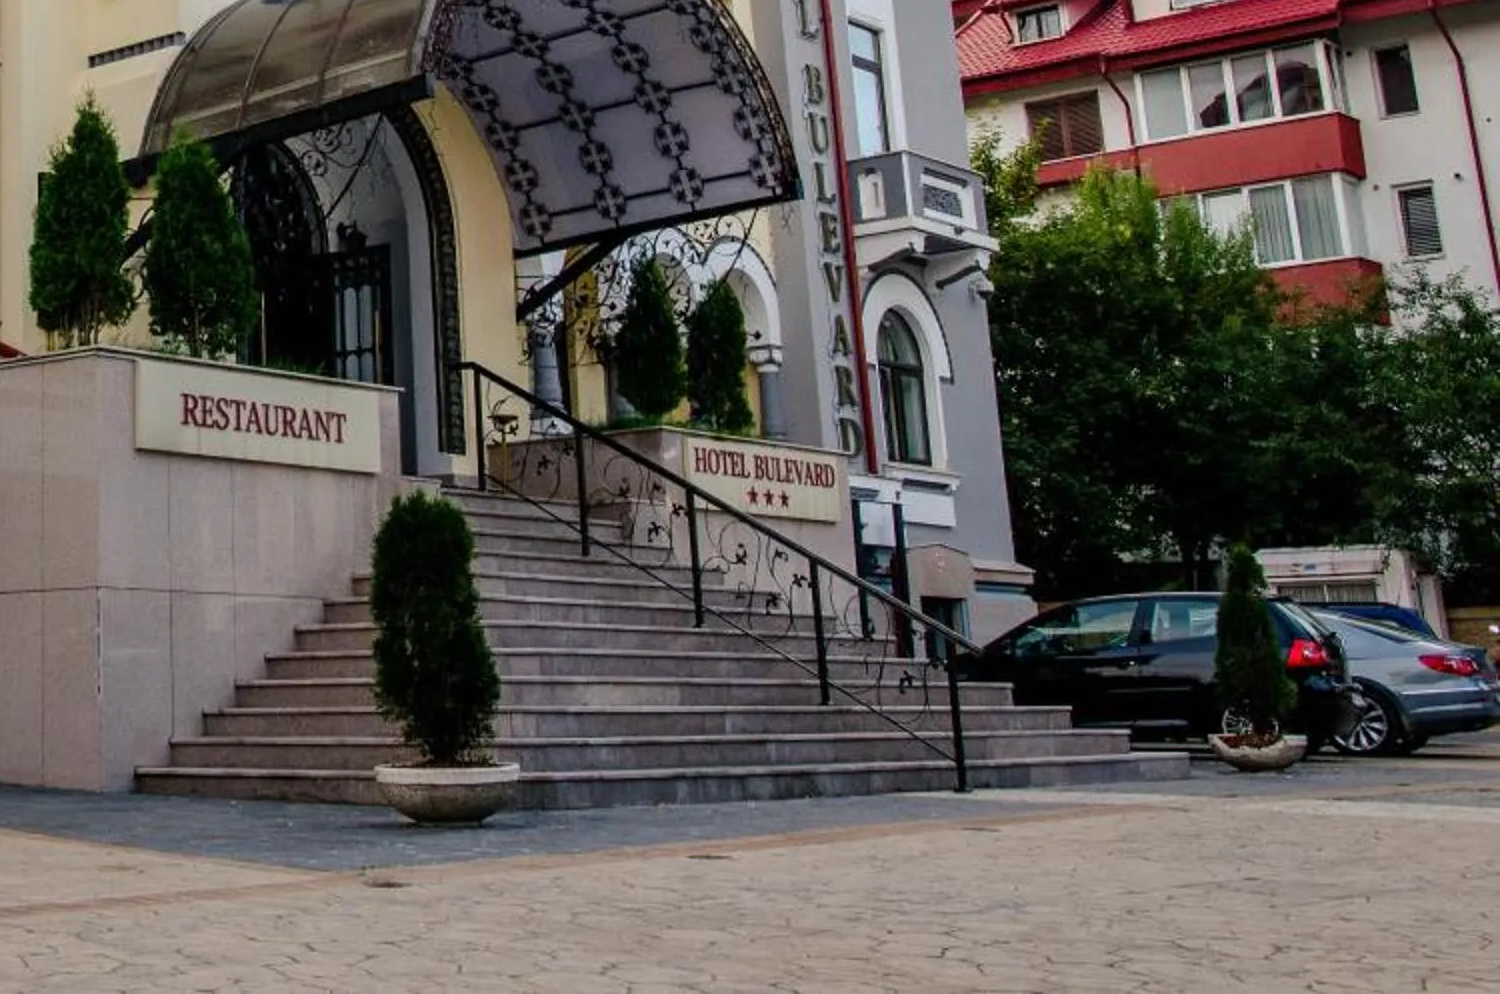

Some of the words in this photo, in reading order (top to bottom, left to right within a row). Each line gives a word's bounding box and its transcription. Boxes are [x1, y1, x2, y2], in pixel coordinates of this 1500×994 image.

[804, 63, 864, 457] BULEVARD
[180, 393, 346, 443] RESTAURANT
[694, 447, 750, 478] HOTEL
[754, 455, 835, 488] BULEVARD
